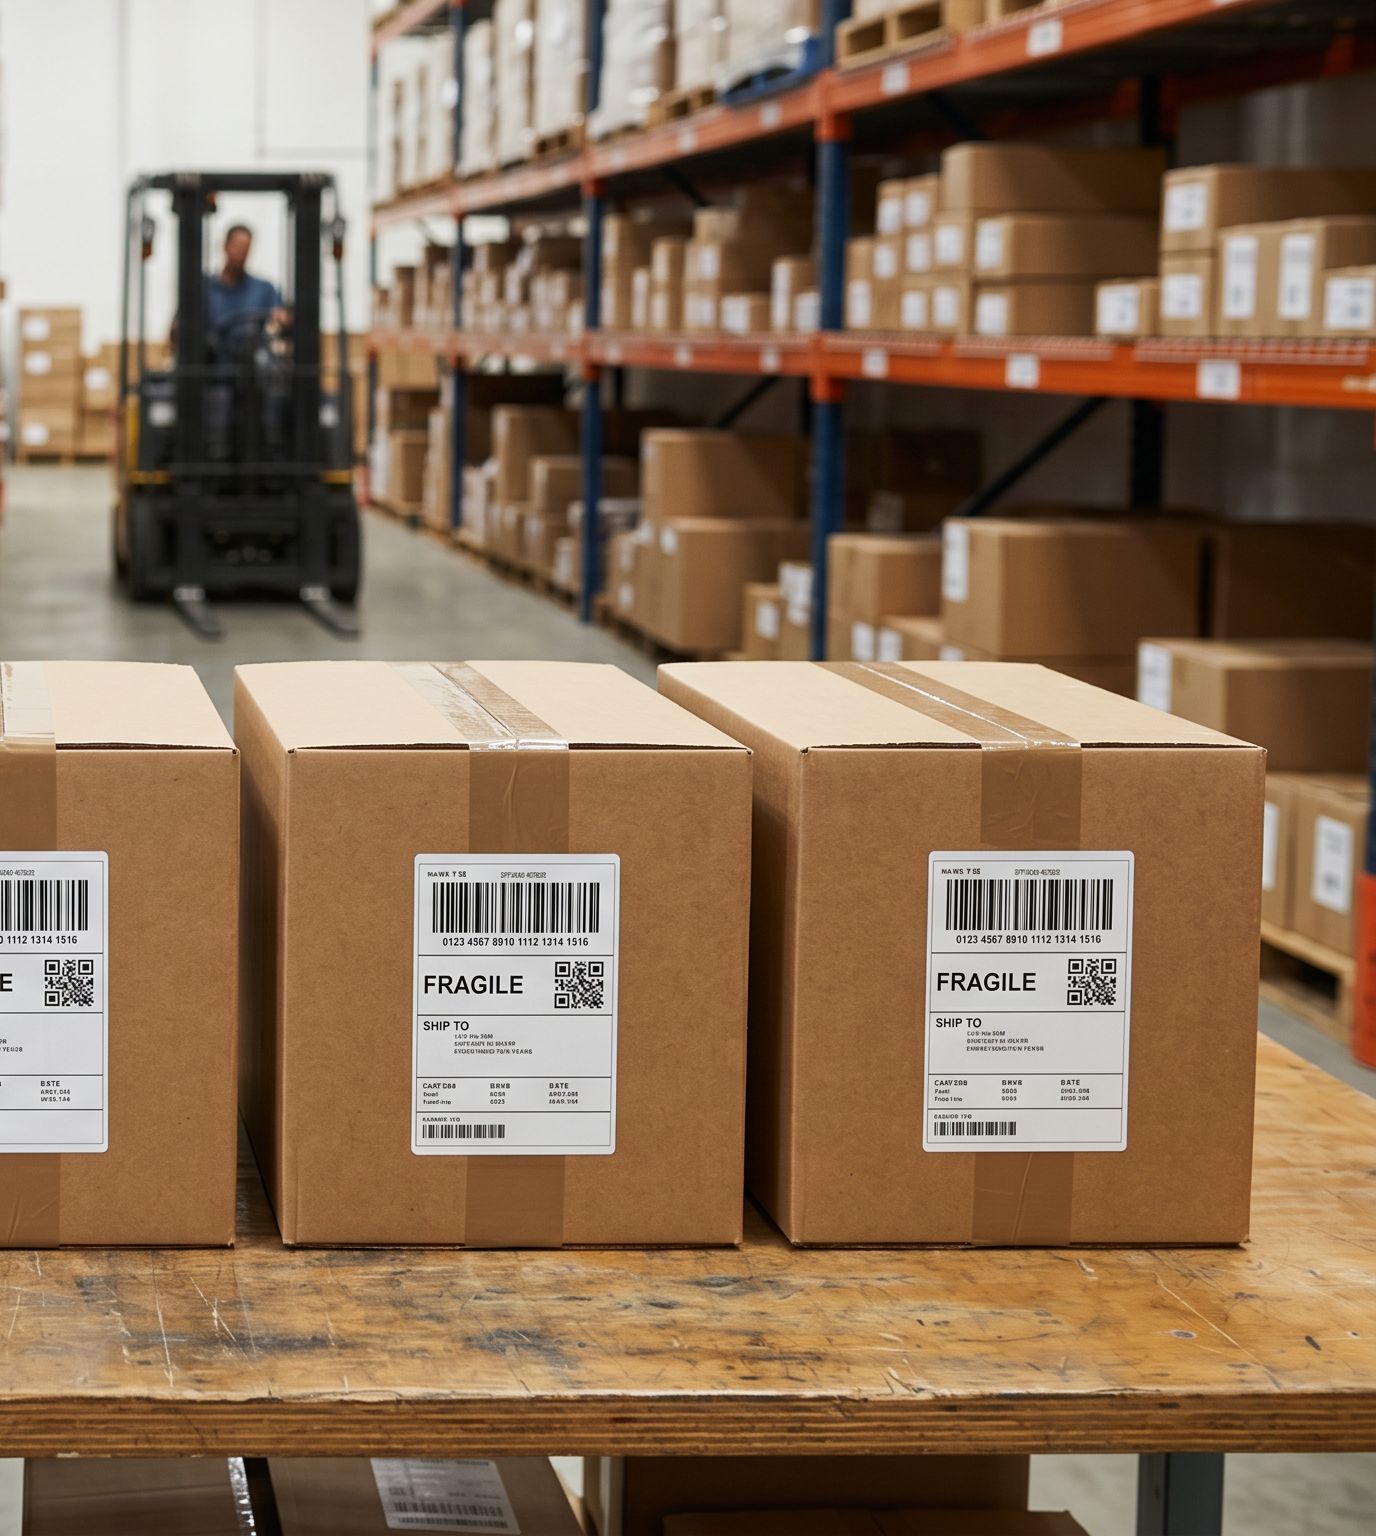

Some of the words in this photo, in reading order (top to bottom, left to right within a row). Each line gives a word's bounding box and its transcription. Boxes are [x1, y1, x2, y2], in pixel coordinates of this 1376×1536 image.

[8, 936, 27, 944] 1112
[31, 936, 52, 944] 1314
[56, 936, 77, 944] 1516
[443, 938, 464, 946] 0123
[468, 938, 489, 946] 4567
[493, 938, 514, 946] 8910
[519, 938, 538, 946] 1112
[543, 938, 563, 946] 1314
[567, 938, 588, 946] 1516
[956, 935, 978, 943] 0123
[981, 935, 1002, 943] 4567
[1006, 935, 1027, 943] 8910
[1032, 935, 1051, 943] 1112
[1055, 935, 1076, 943] 1314
[1080, 935, 1101, 943] 1516
[425, 975, 523, 994] FRAGILE
[938, 973, 1036, 991] FRAGILE
[424, 1021, 450, 1030] SHIP
[454, 1021, 469, 1030] TO
[936, 1018, 962, 1027] SHIP
[966, 1018, 981, 1028] TO
